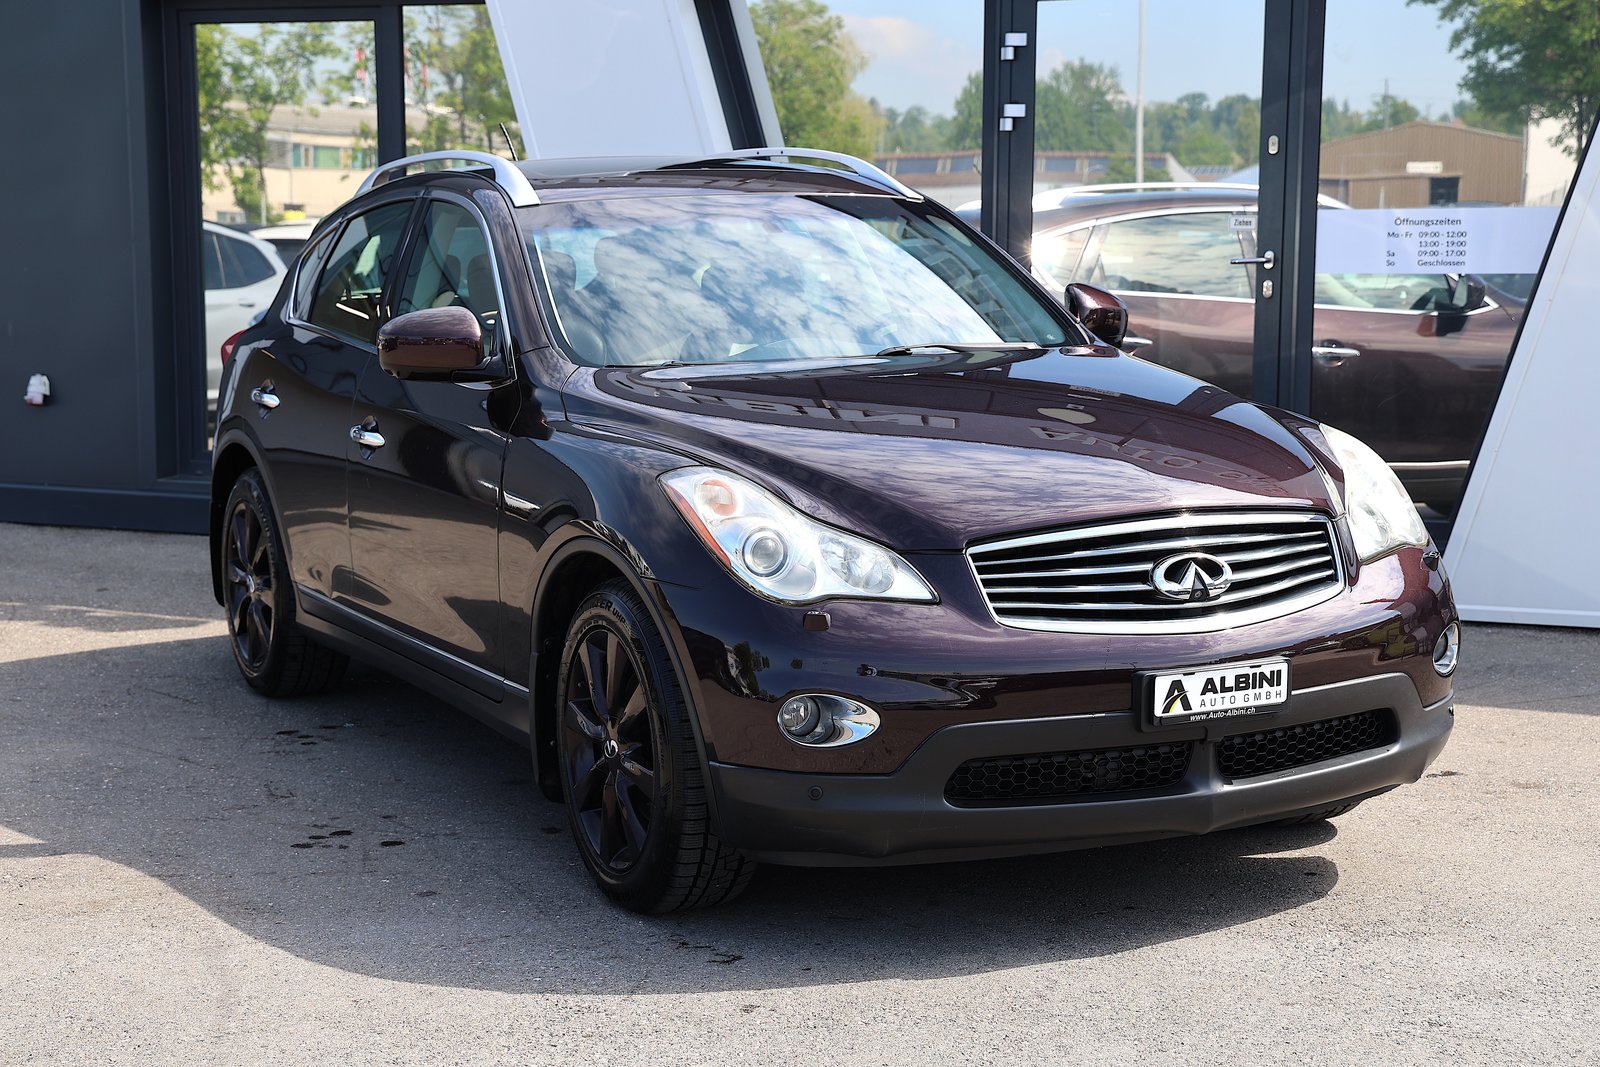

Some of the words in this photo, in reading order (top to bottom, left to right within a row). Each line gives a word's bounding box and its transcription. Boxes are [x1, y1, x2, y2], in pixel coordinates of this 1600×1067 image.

[1394, 217, 1462, 227] Öffnungszeiten
[1419, 240, 1440, 248] 13:00
[1200, 669, 1282, 696] ALBINI
[1200, 695, 1236, 708] AUTO
[1243, 690, 1282, 703] GMBH
[1190, 707, 1256, 721] www.Auto-Albini.ch
